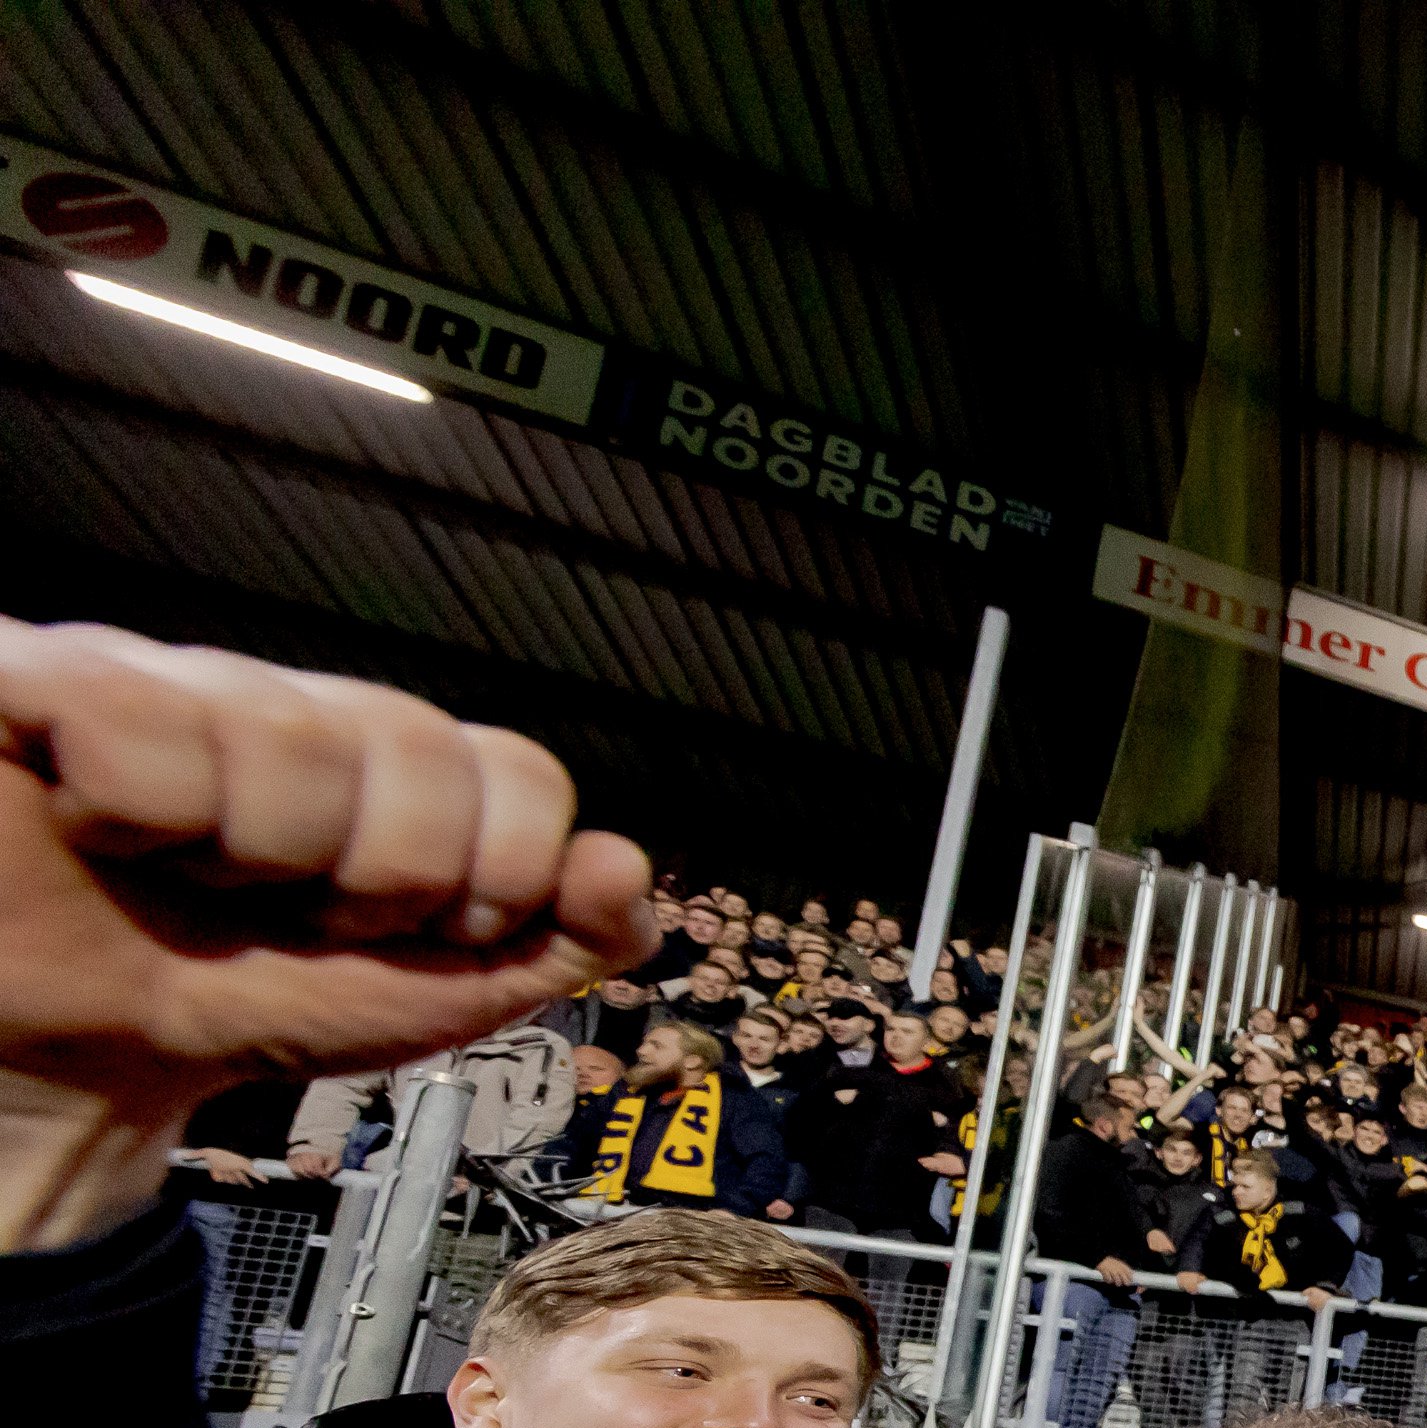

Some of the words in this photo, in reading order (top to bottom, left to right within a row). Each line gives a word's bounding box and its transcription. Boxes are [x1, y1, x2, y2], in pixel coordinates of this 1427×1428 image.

[199, 229, 547, 391] NOORD
[660, 416, 990, 552] NOORDEN
[667, 378, 996, 518] DAGBLAD
[1132, 555, 1386, 672] Emmer
